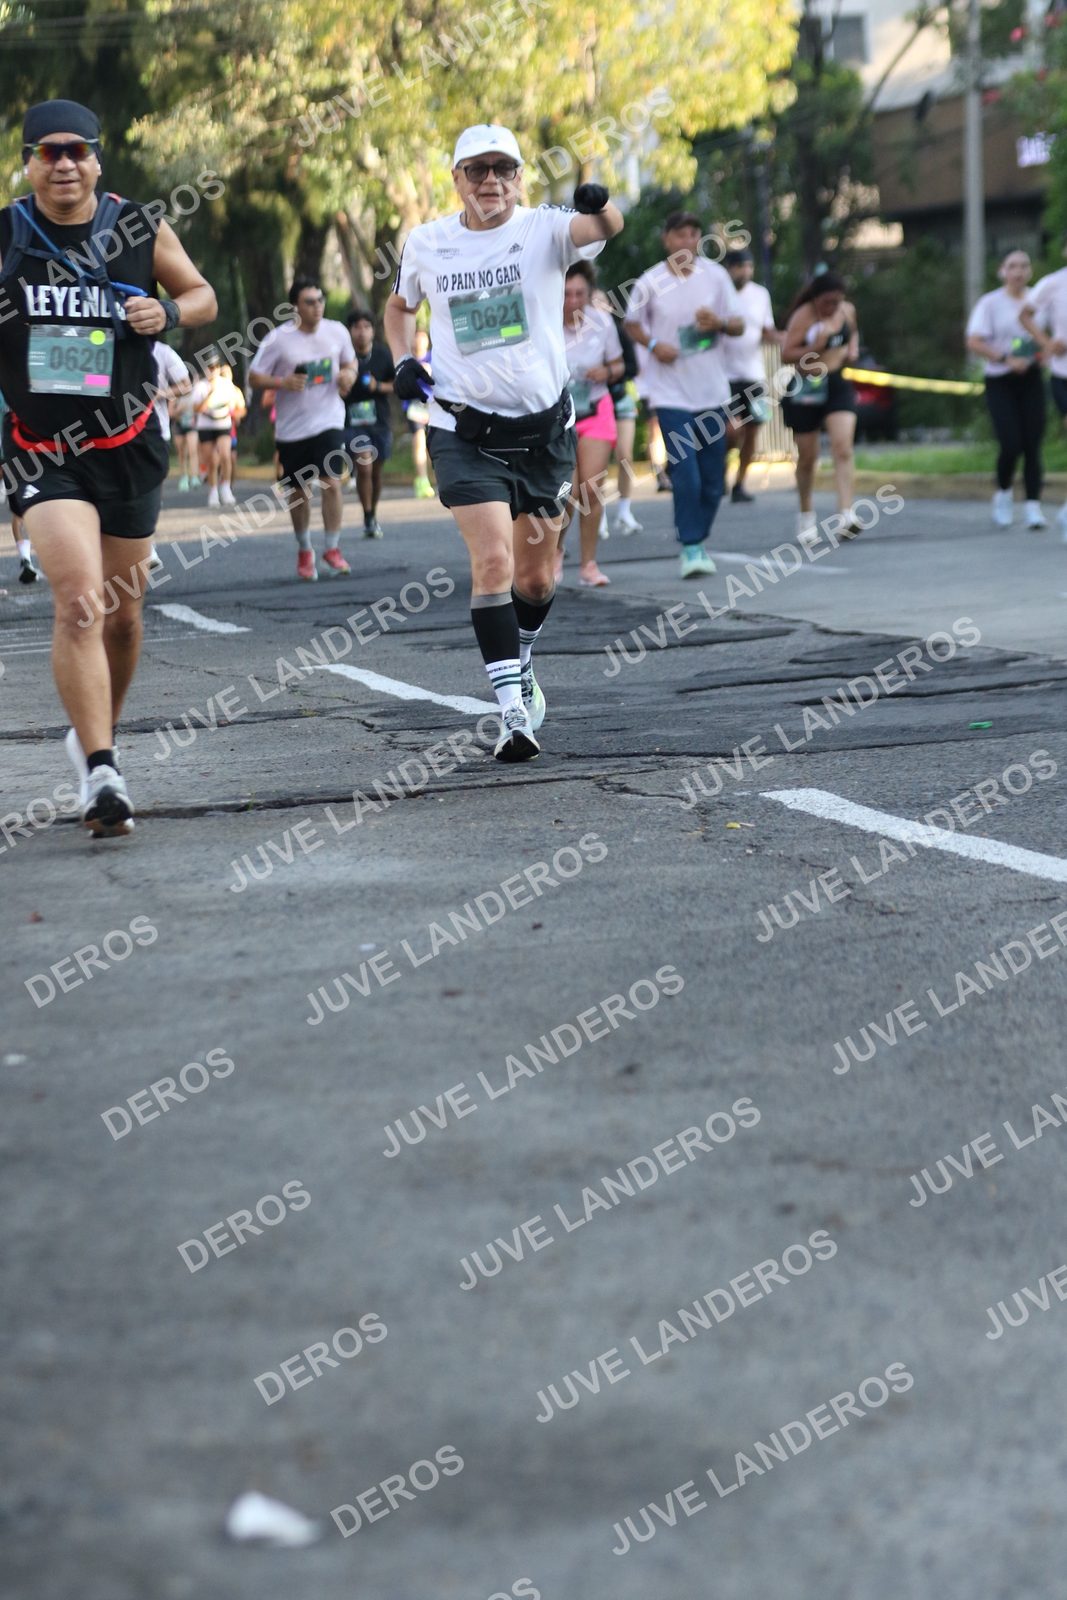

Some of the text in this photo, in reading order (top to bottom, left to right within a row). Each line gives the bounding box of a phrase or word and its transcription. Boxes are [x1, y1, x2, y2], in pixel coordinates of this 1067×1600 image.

[436, 263, 521, 293] NO PAIN NO GAIN
[470, 301, 523, 331] 0621
[49, 345, 111, 374] 0620
